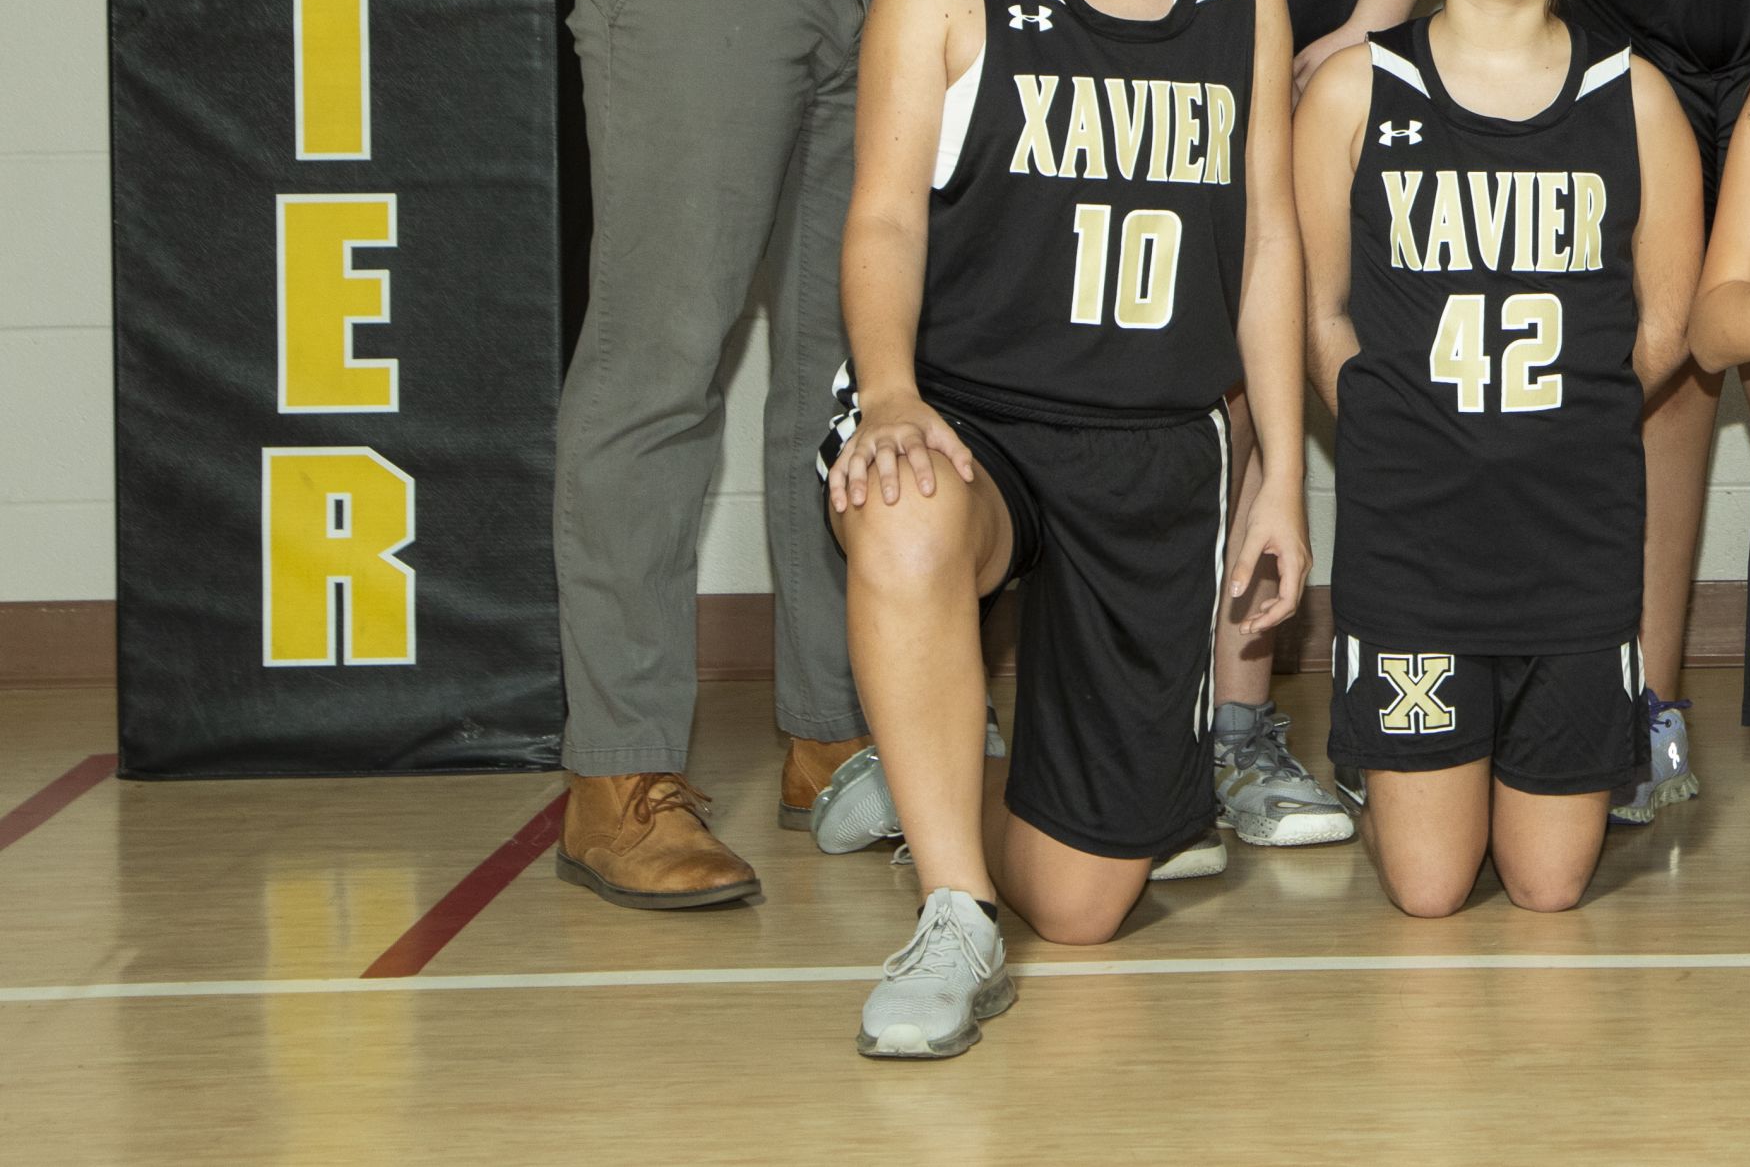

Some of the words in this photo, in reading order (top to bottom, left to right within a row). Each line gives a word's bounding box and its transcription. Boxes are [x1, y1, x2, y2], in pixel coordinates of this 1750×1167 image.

[1009, 74, 1236, 185] XAVIER
[1070, 204, 1182, 329] 10
[1381, 171, 1607, 272] XAVIER
[1429, 293, 1563, 413] 42
[1378, 653, 1455, 734] X
